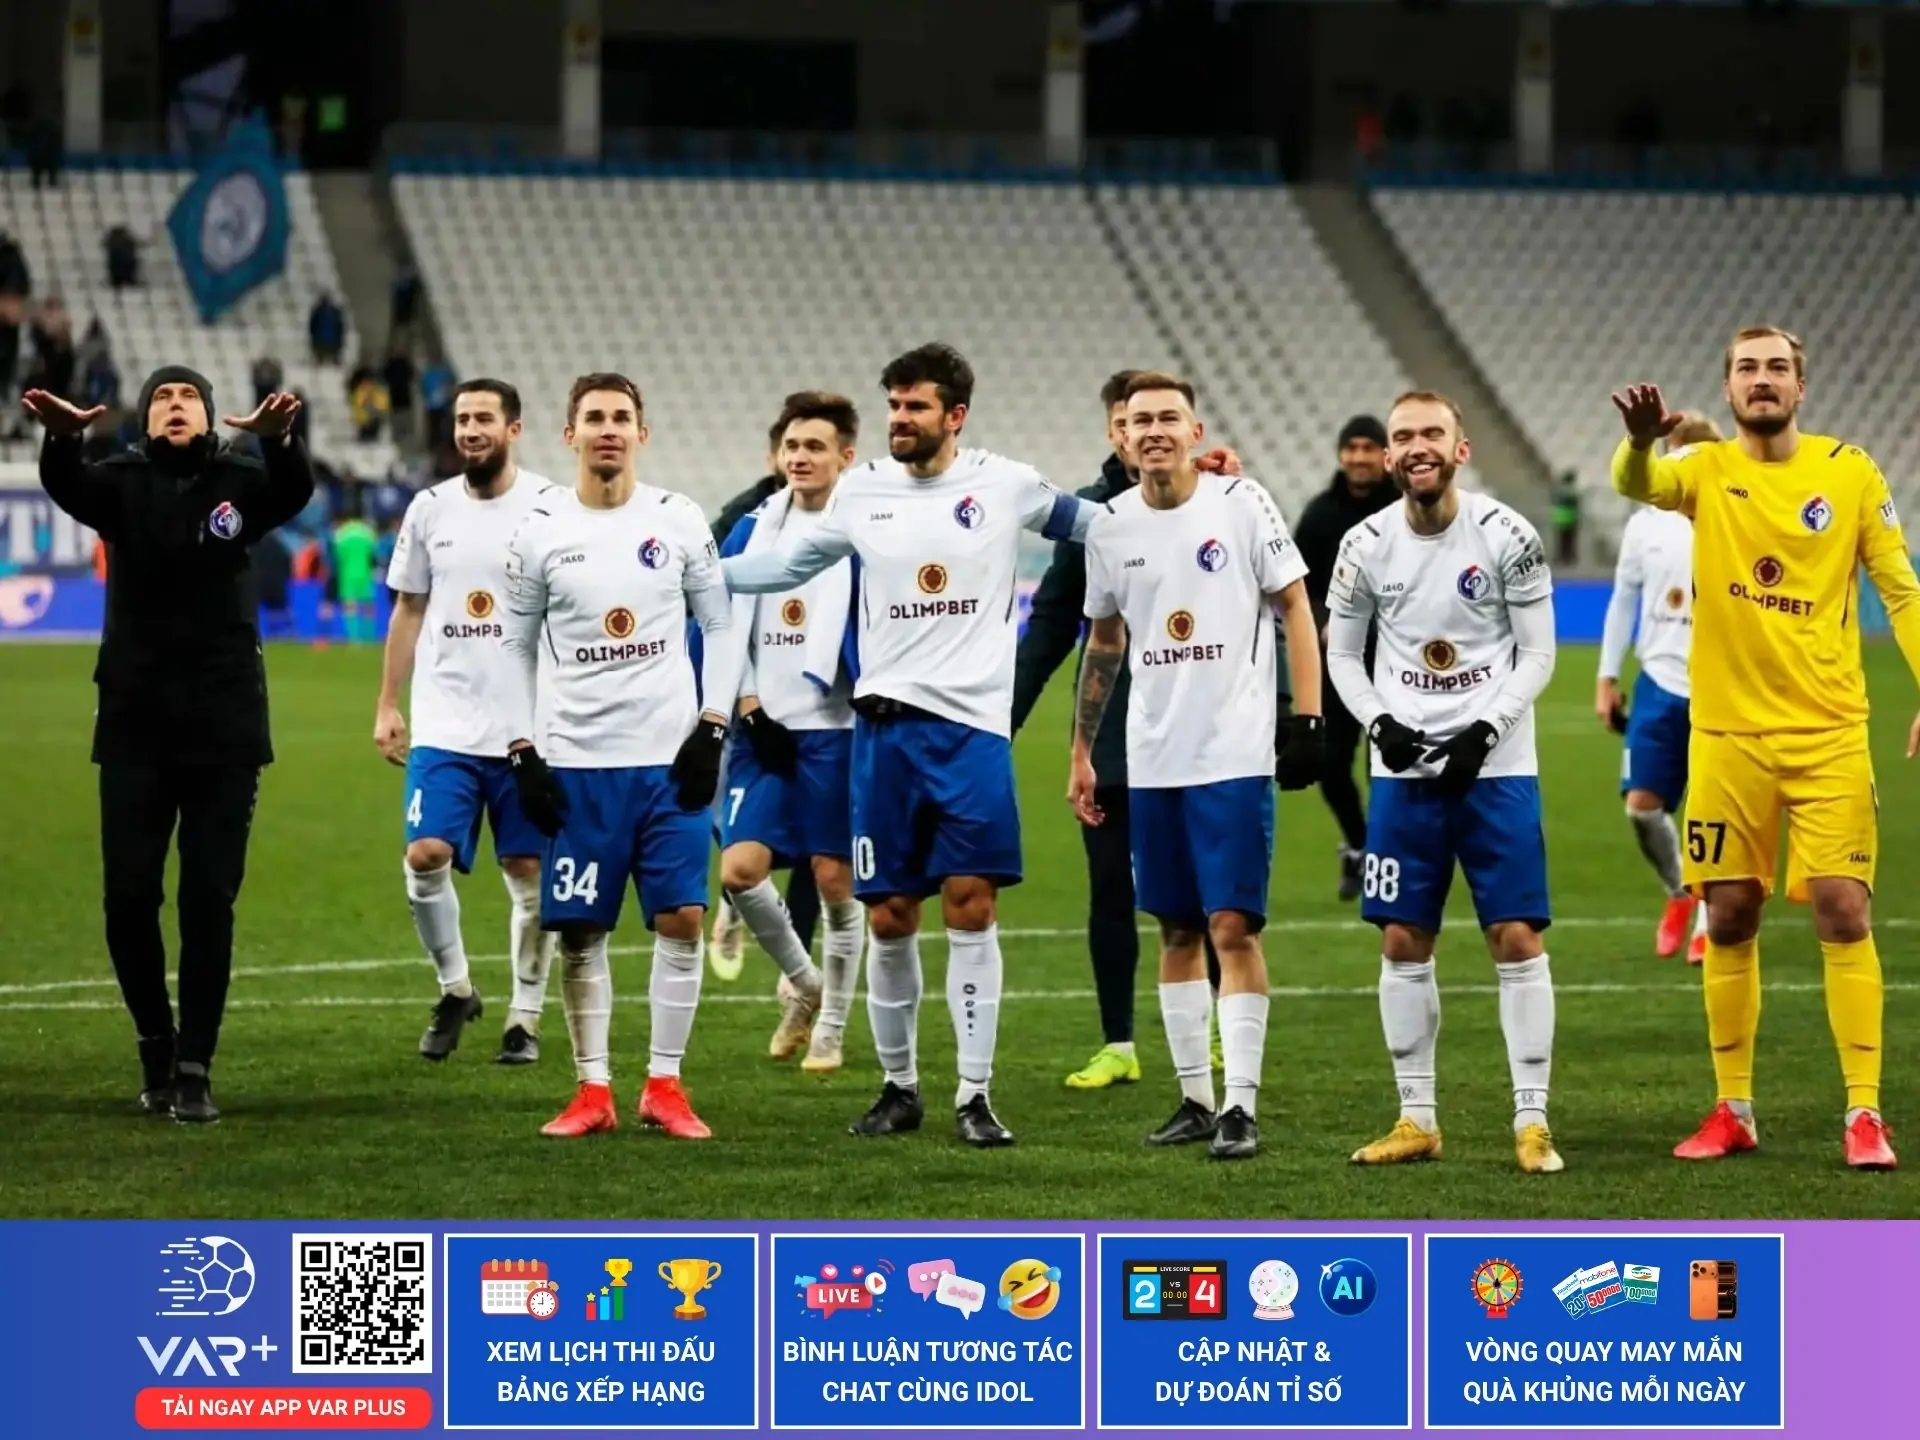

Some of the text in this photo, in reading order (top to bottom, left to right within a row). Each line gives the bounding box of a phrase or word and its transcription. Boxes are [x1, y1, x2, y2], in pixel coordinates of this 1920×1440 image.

[559, 553, 586, 565] JAKO
[890, 598, 979, 619] OLIMPBET
[1729, 582, 1815, 617] OLMPBET
[575, 639, 667, 663] OLIMPBET
[763, 631, 806, 646] OIMP
[1142, 644, 1225, 666] OLIMPBET
[1401, 665, 1492, 690] OLIMPBET
[406, 788, 423, 828] 4
[728, 787, 746, 827] 7
[1687, 819, 1729, 865] 57
[552, 856, 600, 906] 34
[1363, 852, 1401, 903] 88
